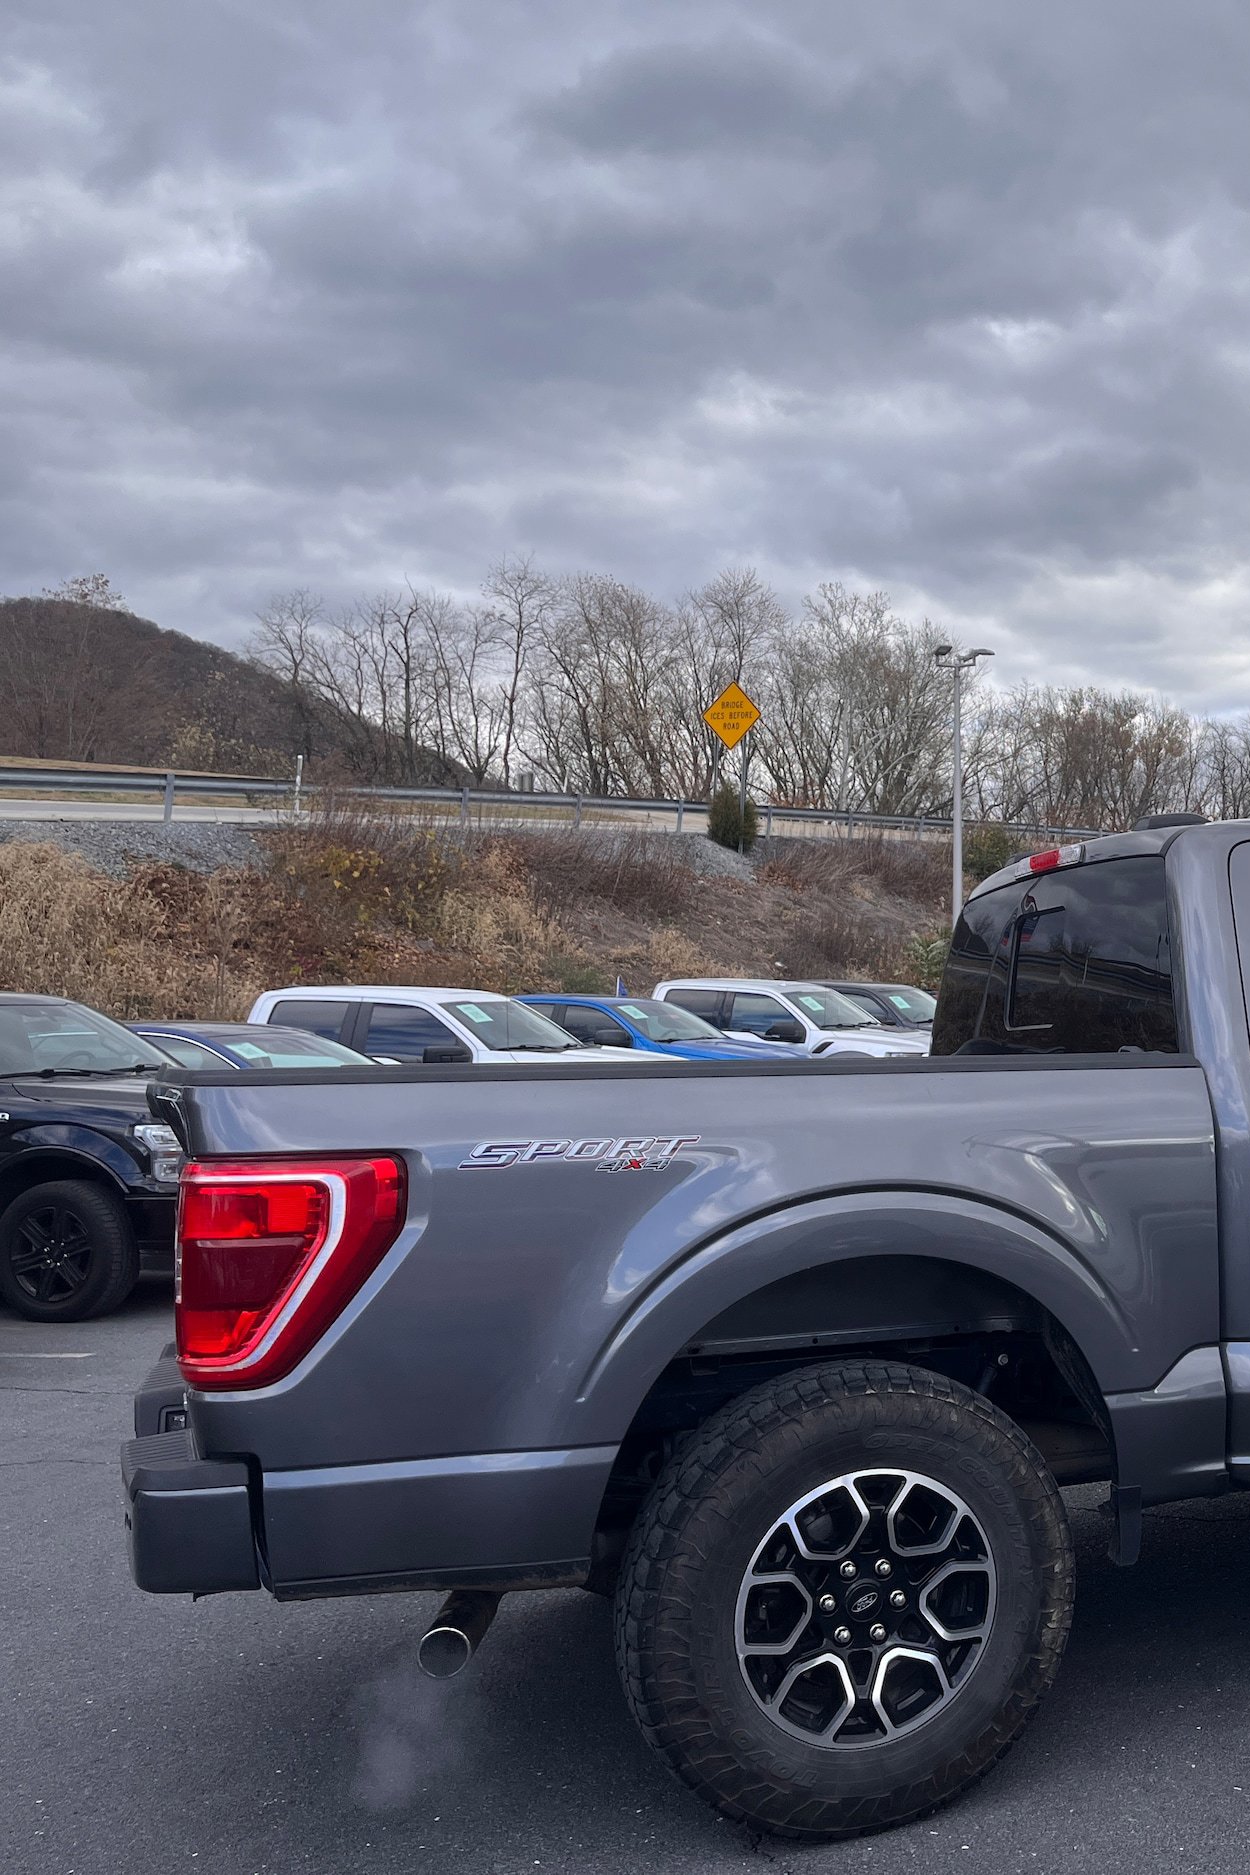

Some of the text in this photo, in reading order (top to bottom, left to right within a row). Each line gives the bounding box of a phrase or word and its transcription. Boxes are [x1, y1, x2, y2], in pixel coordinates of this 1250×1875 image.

[721, 701, 744, 709] BRIDGE
[710, 711, 753, 720] ICES BEFORE
[723, 722, 740, 730] ROAD
[457, 1134, 702, 1170] SPORT
[862, 1431, 959, 1462] OPEN
[853, 1594, 876, 1611] Ford
[729, 1727, 819, 1789] TOYO
